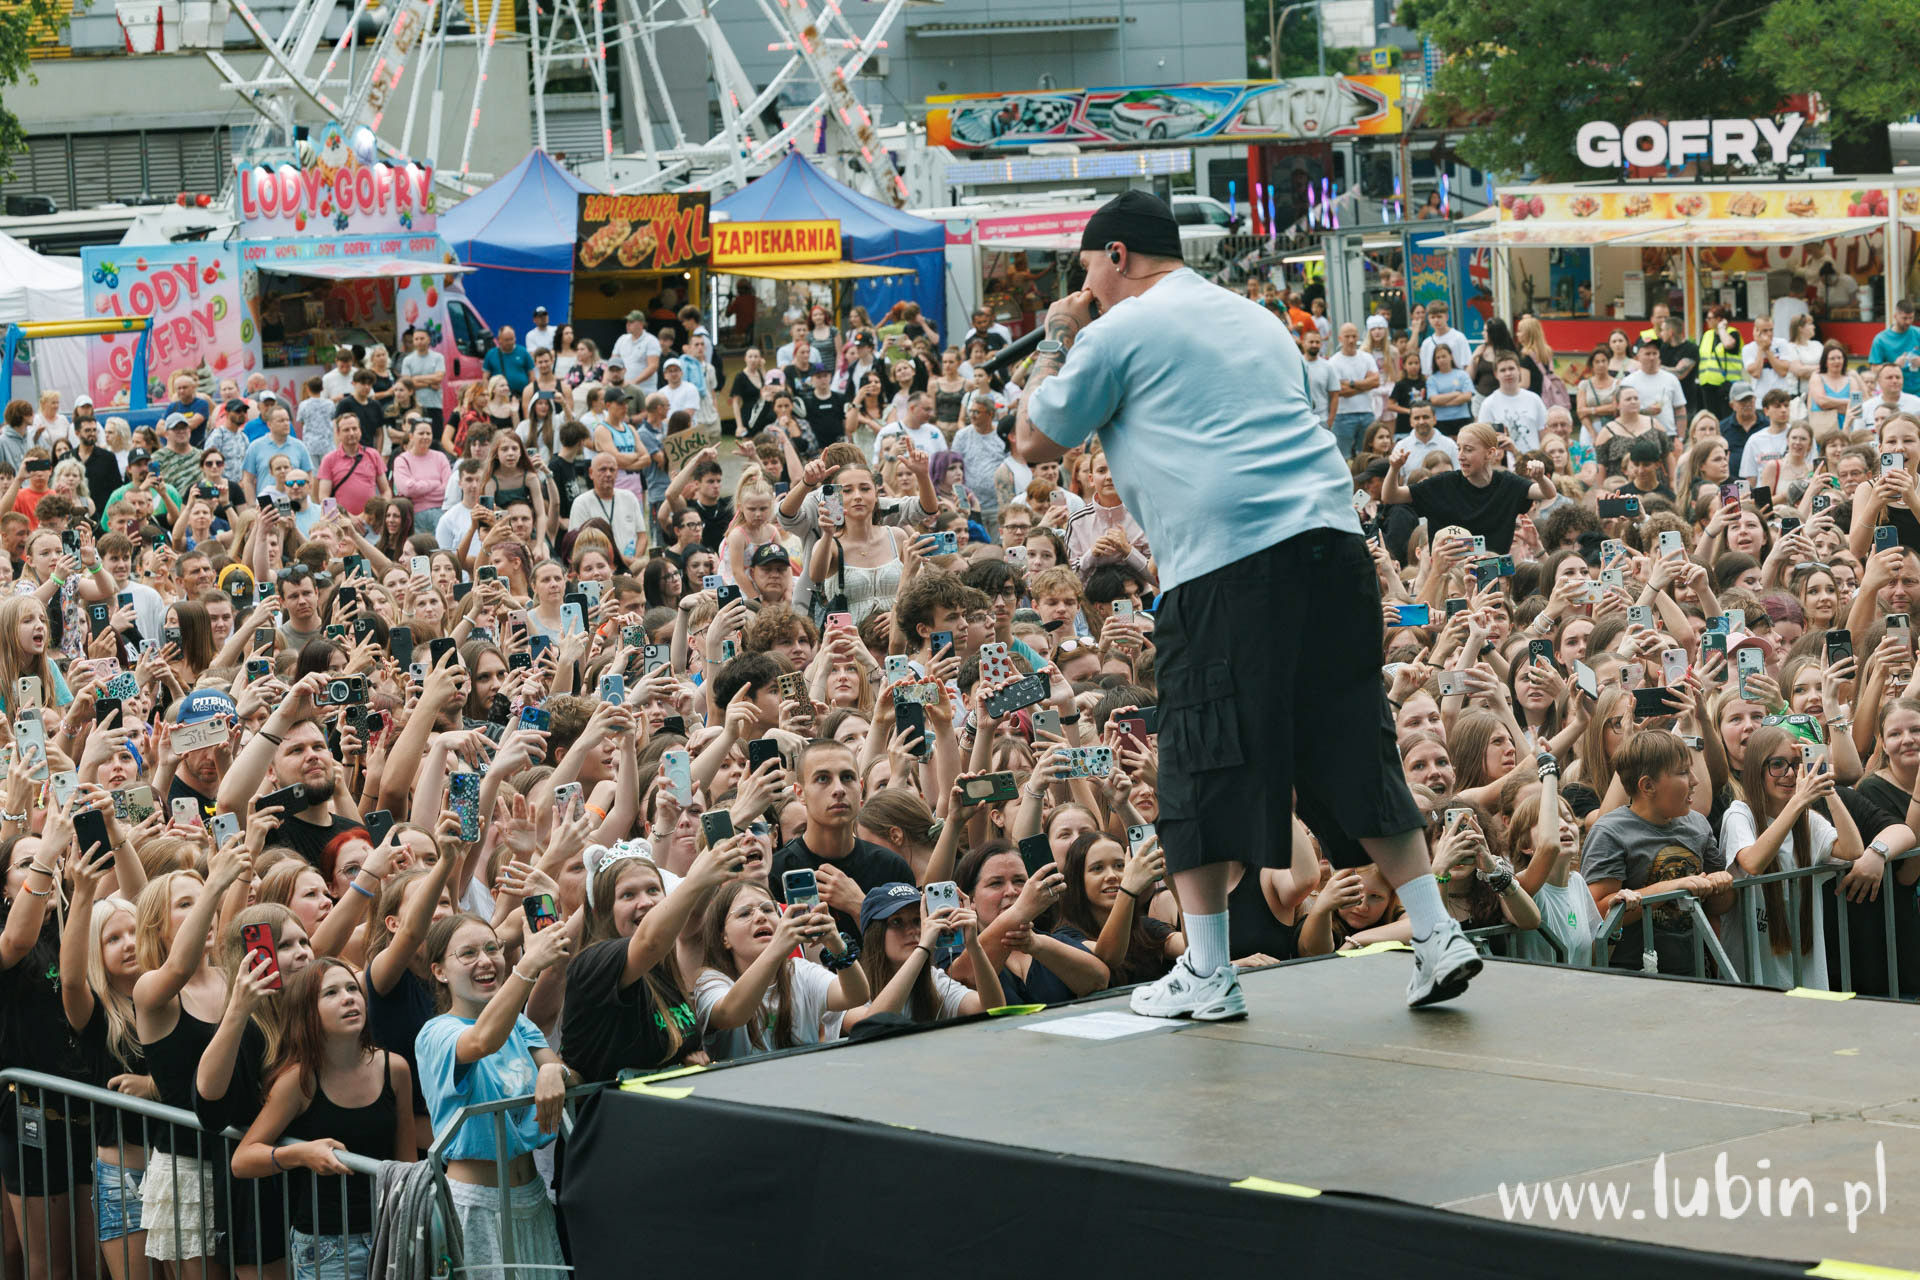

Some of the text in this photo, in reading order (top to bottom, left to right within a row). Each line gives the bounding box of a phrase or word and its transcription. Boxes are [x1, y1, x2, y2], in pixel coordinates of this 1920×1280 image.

[1576, 117, 1804, 168] GOFRY
[241, 165, 434, 218] LODY GOFRY
[584, 194, 679, 222] ZAPIEKANKA
[652, 204, 711, 269] XXL
[717, 228, 838, 255] ZAPIEKARNIA
[110, 256, 199, 320] LODY
[192, 696, 234, 711] PITBULL
[888, 885, 915, 896] VENICE
